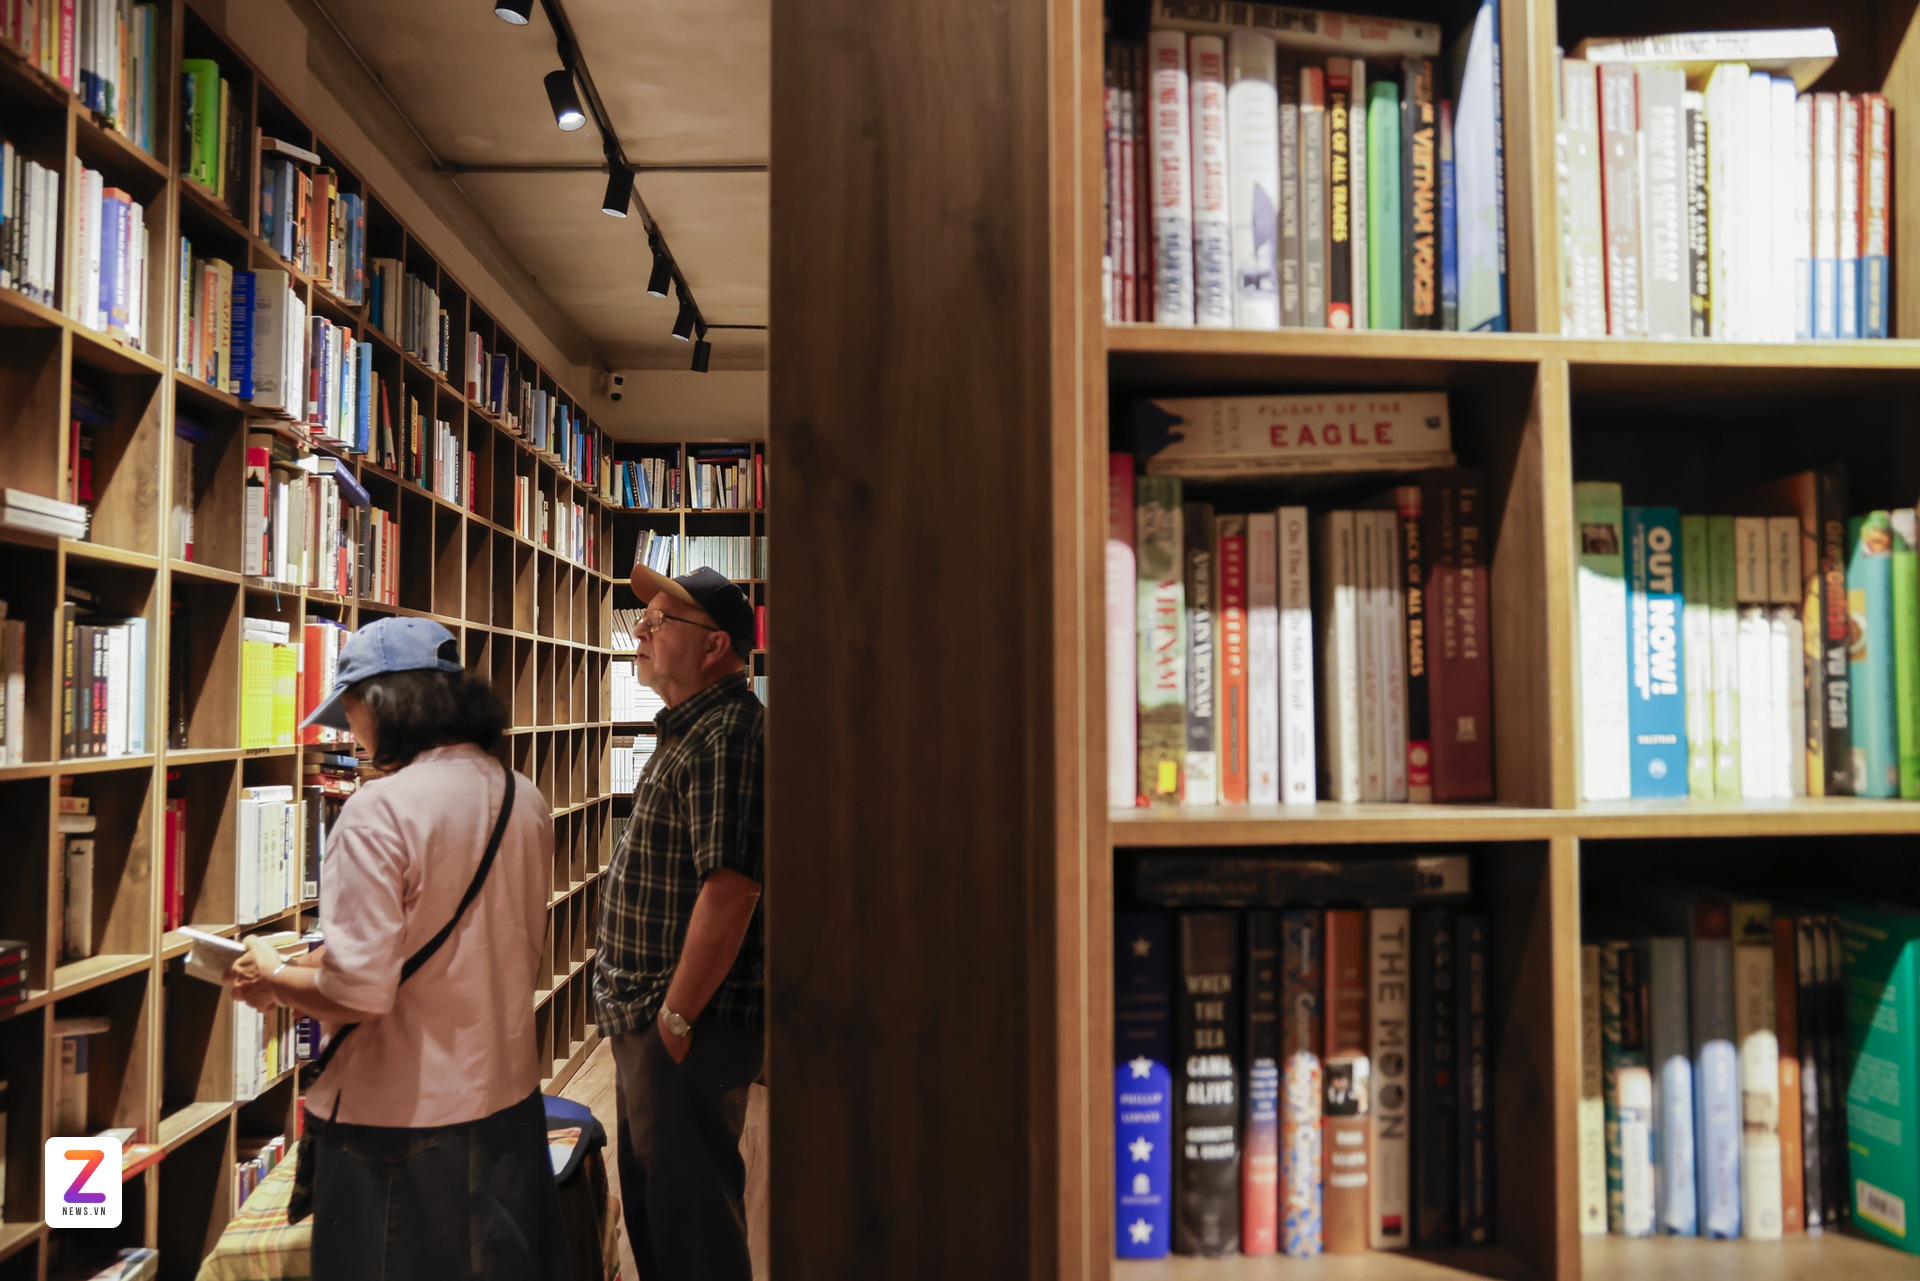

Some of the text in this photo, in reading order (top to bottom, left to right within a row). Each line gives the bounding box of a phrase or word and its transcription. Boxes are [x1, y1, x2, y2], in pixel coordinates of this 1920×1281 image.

[62, 14, 73, 79] NETWORK
[193, 112, 202, 145] YOU
[1161, 156, 1182, 208] SAIGON
[1203, 160, 1224, 212] SAIGON
[1331, 93, 1348, 243] JACK OF ALL TRADES
[1412, 128, 1434, 233] VIETNAM
[1283, 180, 1298, 238] HONOR
[1307, 183, 1322, 241] HONOR
[1413, 236, 1434, 316] VOICES
[1623, 255, 1638, 332] VALIANT
[1335, 403, 1356, 414] OF
[1367, 402, 1403, 414] THE
[1270, 422, 1395, 449] EAGLE
[1287, 520, 1302, 546] On
[1288, 549, 1303, 577] The
[1458, 488, 1479, 659] In Retrospect
[1408, 588, 1422, 617] ALL
[1648, 526, 1678, 695] OUT NOW!
[1157, 580, 1178, 689] VIETNAM
[1409, 618, 1425, 678] TRADES
[65, 643, 73, 679] KNIGHT
[93, 651, 102, 678] filter
[1827, 645, 1849, 729] vu tran
[64, 689, 72, 713] SHOE
[1185, 973, 1232, 994] WHEN
[1379, 928, 1404, 1004] THE
[1194, 1001, 1224, 1021] THE
[1194, 1028, 1225, 1048] SEA
[1186, 1054, 1233, 1078] CAME
[1379, 1021, 1405, 1140] MOON
[1186, 1081, 1233, 1105] ALIVE
